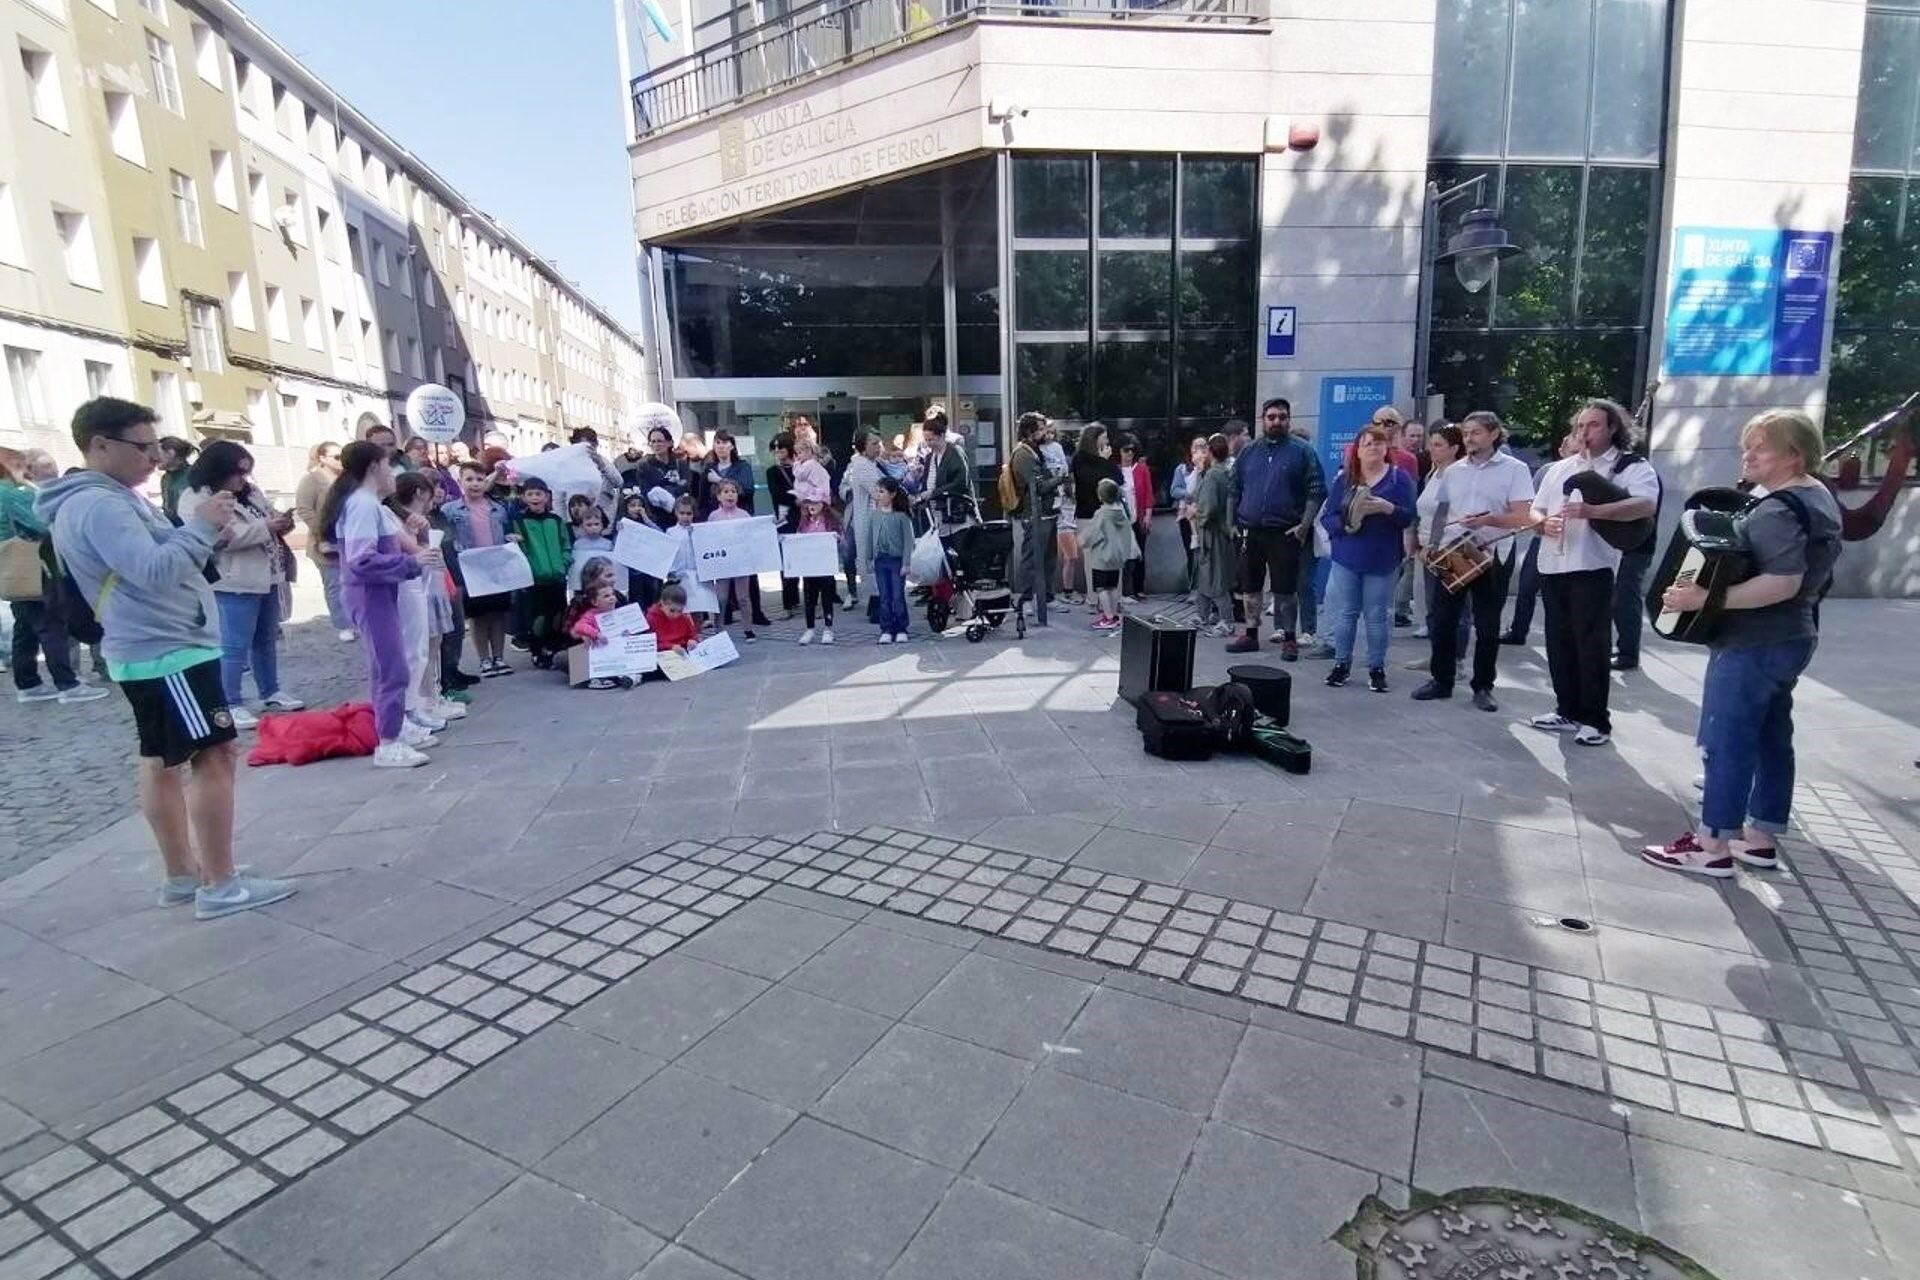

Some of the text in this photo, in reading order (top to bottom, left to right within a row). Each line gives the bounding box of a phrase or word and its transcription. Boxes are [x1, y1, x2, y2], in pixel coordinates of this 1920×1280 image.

[750, 101, 814, 137] XUNTA
[751, 116, 856, 167] DE GALICIA
[656, 134, 949, 230] DELEGACIÓN TERRITORIAL DE FERROL
[1706, 239, 1750, 253] XUNTA
